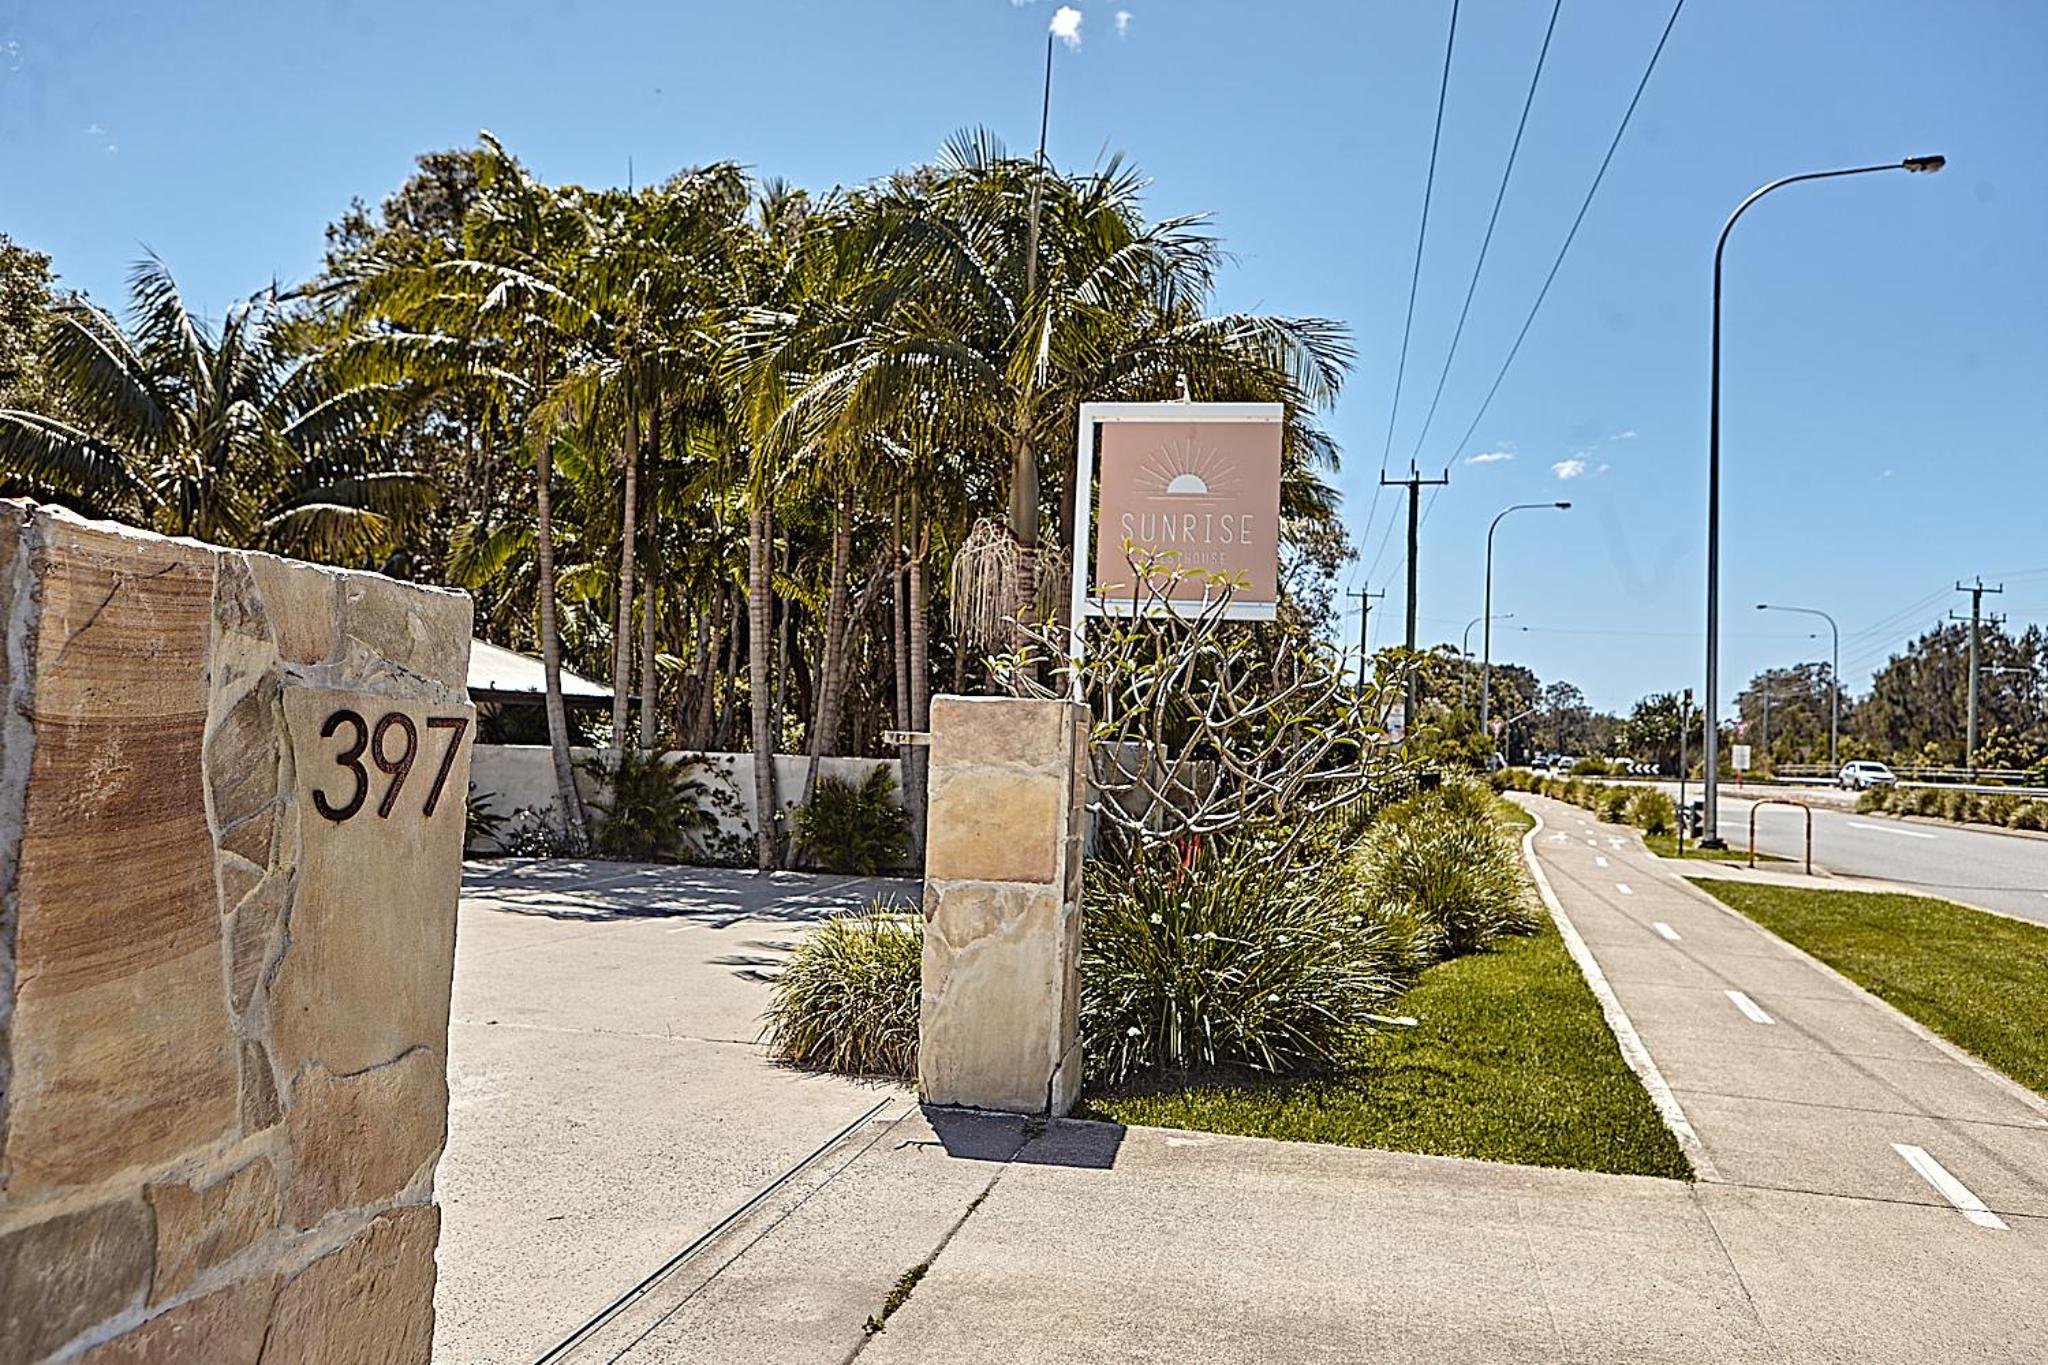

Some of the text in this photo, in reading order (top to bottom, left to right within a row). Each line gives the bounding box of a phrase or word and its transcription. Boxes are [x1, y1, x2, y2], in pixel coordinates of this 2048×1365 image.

[1120, 512, 1253, 545] SUNRISE
[1141, 551, 1227, 565] ESTHOUSE
[313, 709, 470, 822] 397
